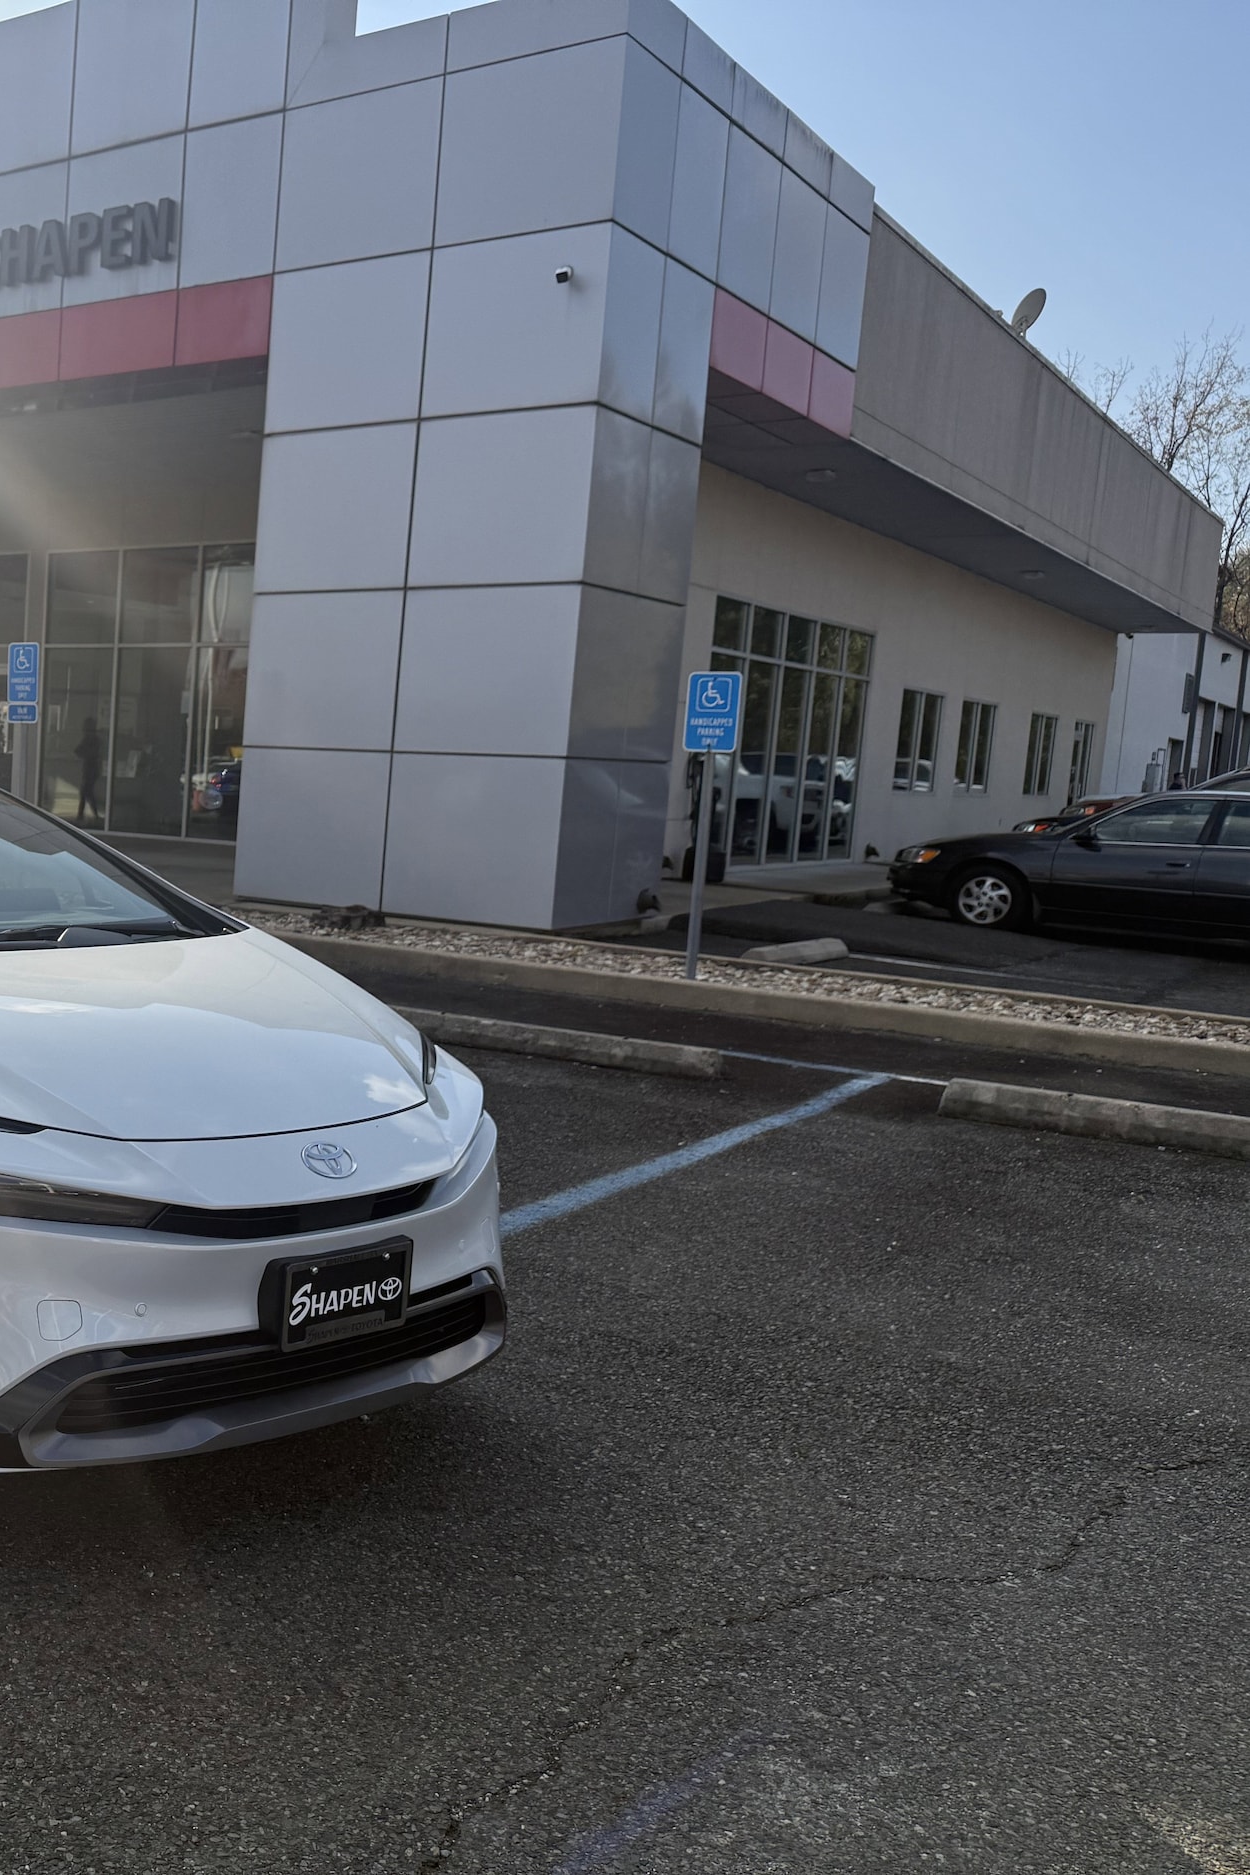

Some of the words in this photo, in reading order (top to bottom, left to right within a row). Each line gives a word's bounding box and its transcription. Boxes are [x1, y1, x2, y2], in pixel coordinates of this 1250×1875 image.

[690, 717, 734, 727] HANDICAPPED
[696, 727, 725, 737] PARKING
[289, 1281, 377, 1326] SHAPEN
[350, 1317, 384, 1332] TOYOTA
